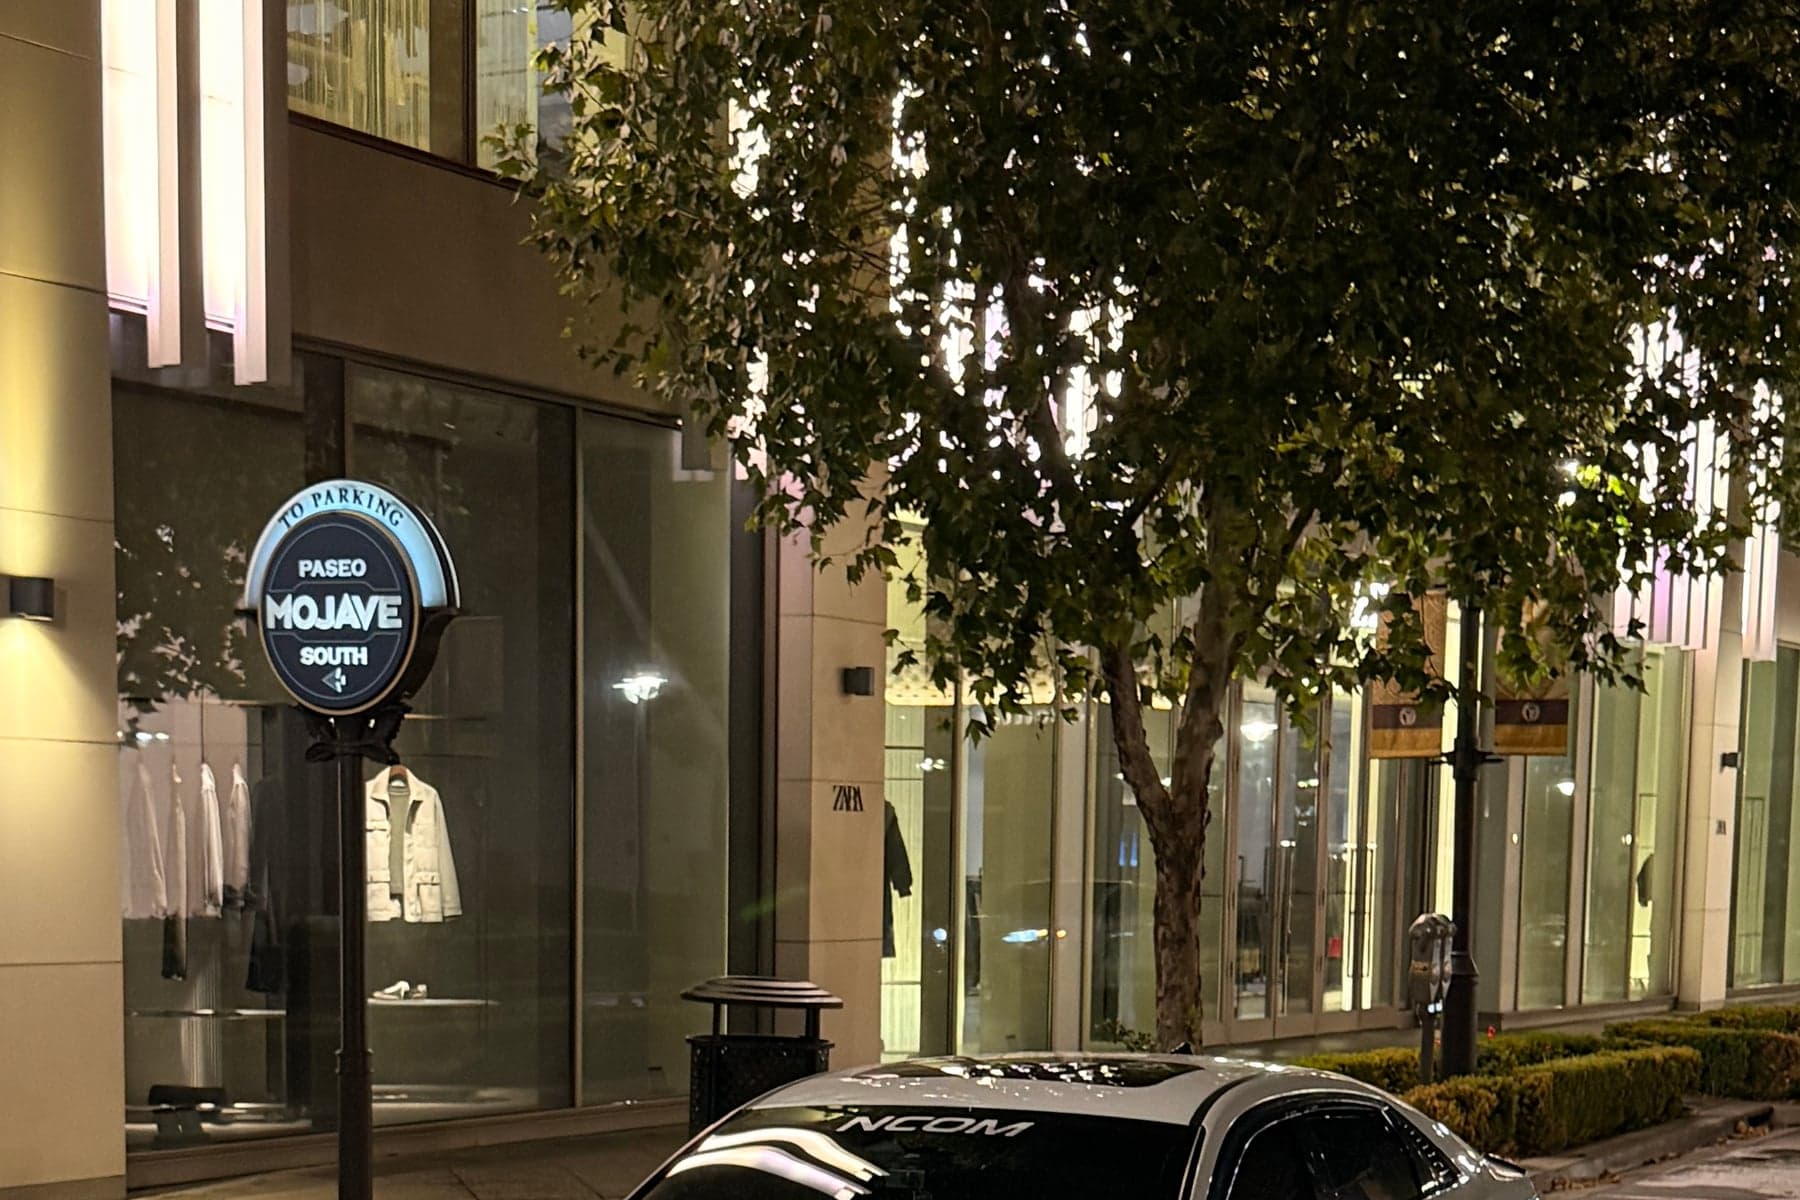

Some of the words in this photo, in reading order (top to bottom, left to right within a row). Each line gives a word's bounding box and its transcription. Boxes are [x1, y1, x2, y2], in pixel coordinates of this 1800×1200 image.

[278, 502, 304, 529] TO
[311, 488, 404, 527] PARKING
[299, 558, 367, 578] PASEO
[265, 593, 402, 631] MOJAVE
[300, 646, 368, 666] SOUTH
[833, 785, 864, 812] ZARA
[836, 1115, 1035, 1137] NCOM
